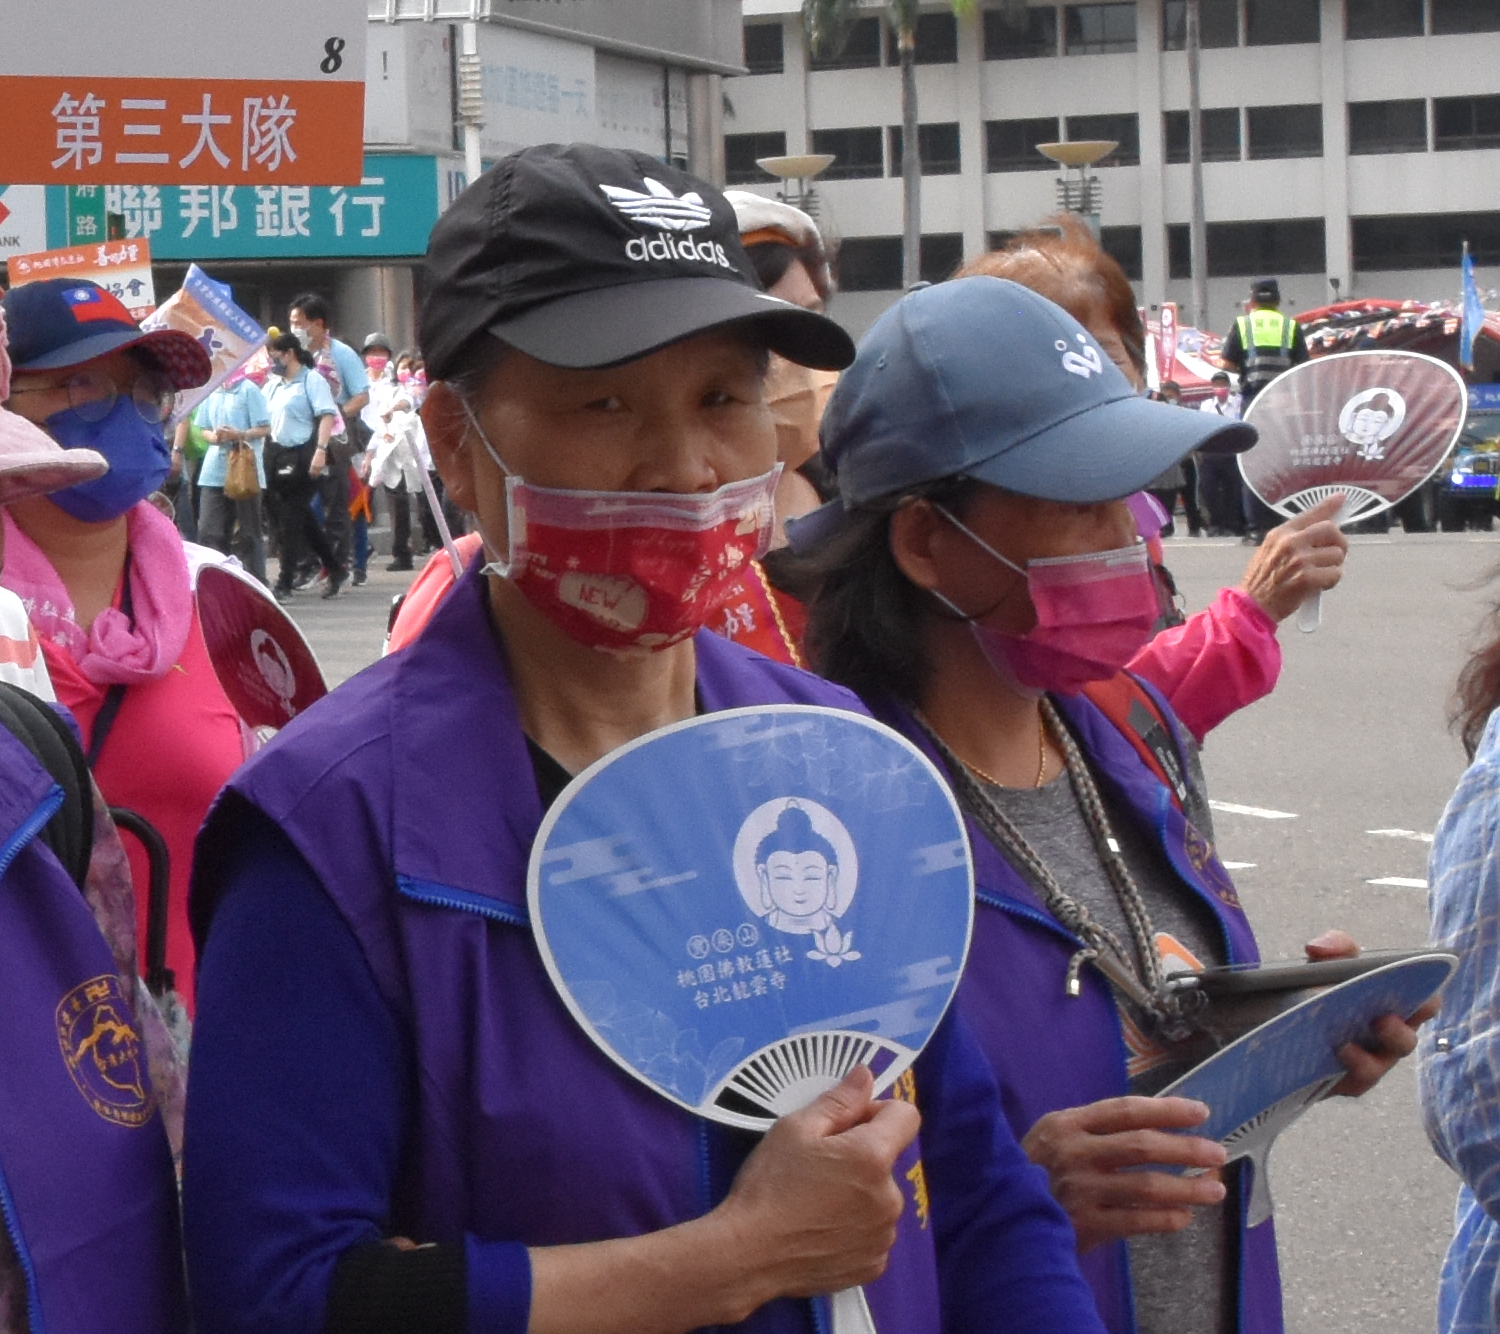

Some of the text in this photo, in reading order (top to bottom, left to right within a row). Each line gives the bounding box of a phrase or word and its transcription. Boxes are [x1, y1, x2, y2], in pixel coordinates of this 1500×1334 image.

[317, 34, 346, 76] 8
[49, 91, 300, 171] 第三大隊
[624, 232, 731, 268] adidas
[677, 945, 794, 988] 桃園佛教蓮社
